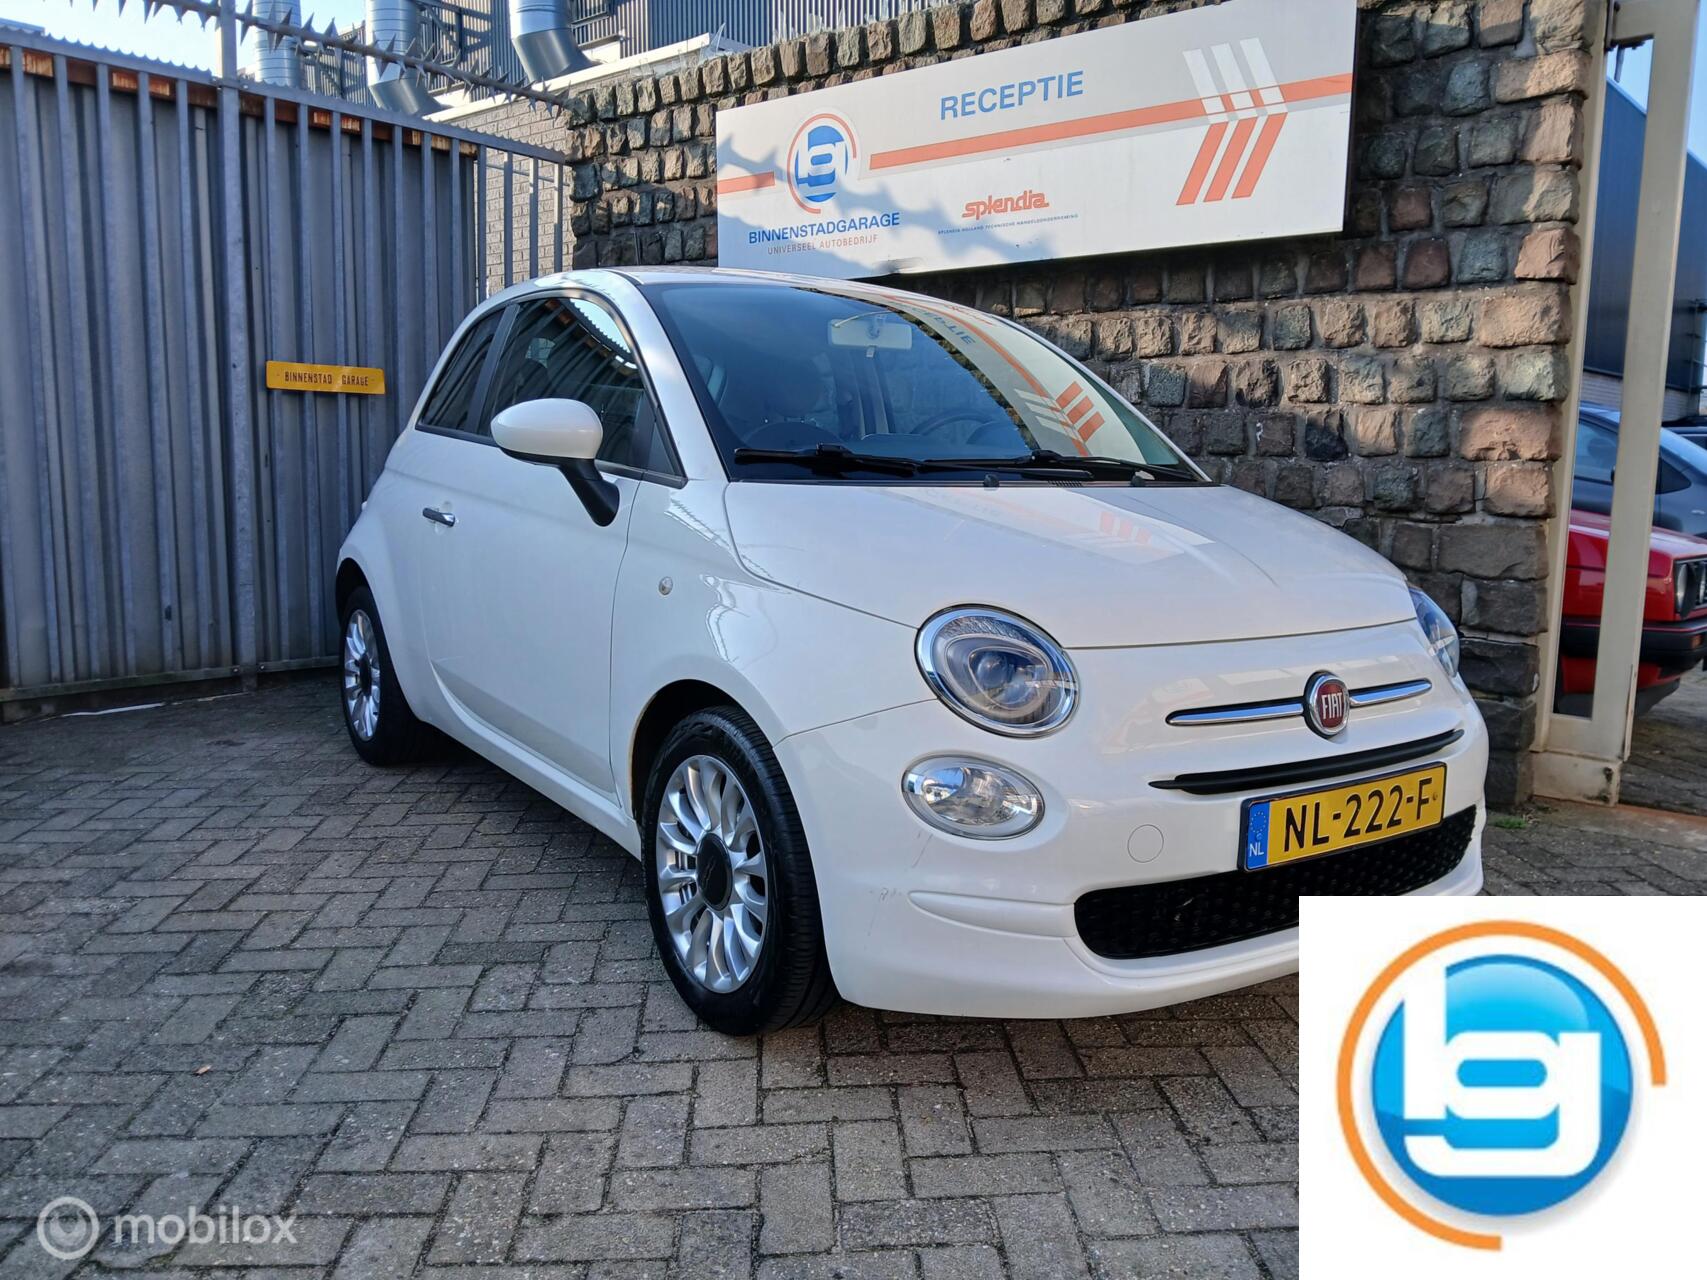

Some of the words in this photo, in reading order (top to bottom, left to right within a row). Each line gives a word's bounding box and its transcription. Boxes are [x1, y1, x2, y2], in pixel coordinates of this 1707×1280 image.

[940, 70, 1084, 121] RECEPTIE
[961, 189, 1050, 221] splendia
[749, 212, 900, 244] BINNENSTADGARAGE
[767, 242, 816, 255] UNIVERSEEL
[819, 234, 879, 249] AUTOBEDRIJF
[284, 371, 333, 385] BINNENSTAD
[341, 374, 369, 387] GARAGE
[1321, 692, 1343, 720] FIAT
[1249, 841, 1265, 857] NL
[1283, 777, 1433, 853] NL-222-F
